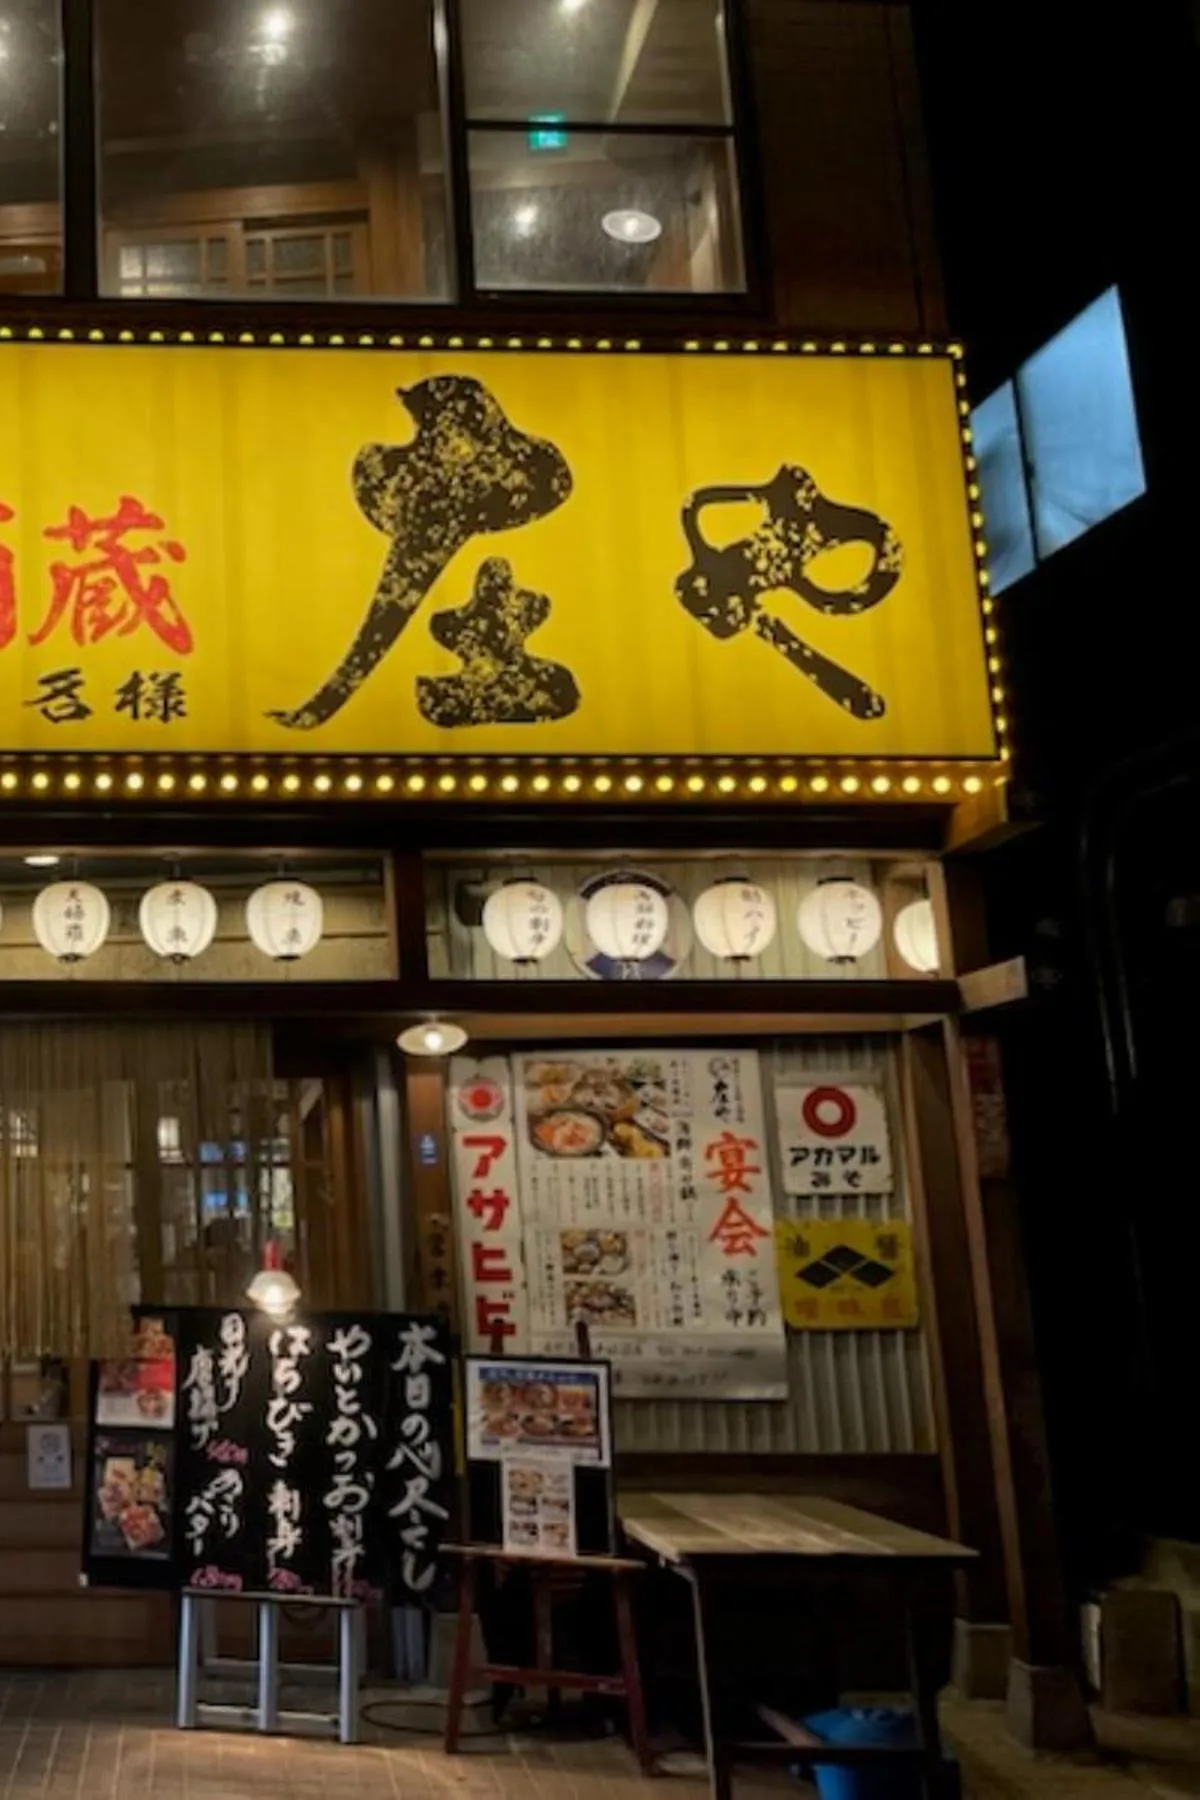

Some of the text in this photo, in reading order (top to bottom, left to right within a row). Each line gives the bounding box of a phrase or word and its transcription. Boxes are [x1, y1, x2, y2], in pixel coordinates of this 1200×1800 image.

[262, 374, 904, 730] 庄や
[704, 1130, 771, 1258] 宴会
[790, 1146, 881, 1168] アカマル
[810, 1170, 863, 1188] みそ
